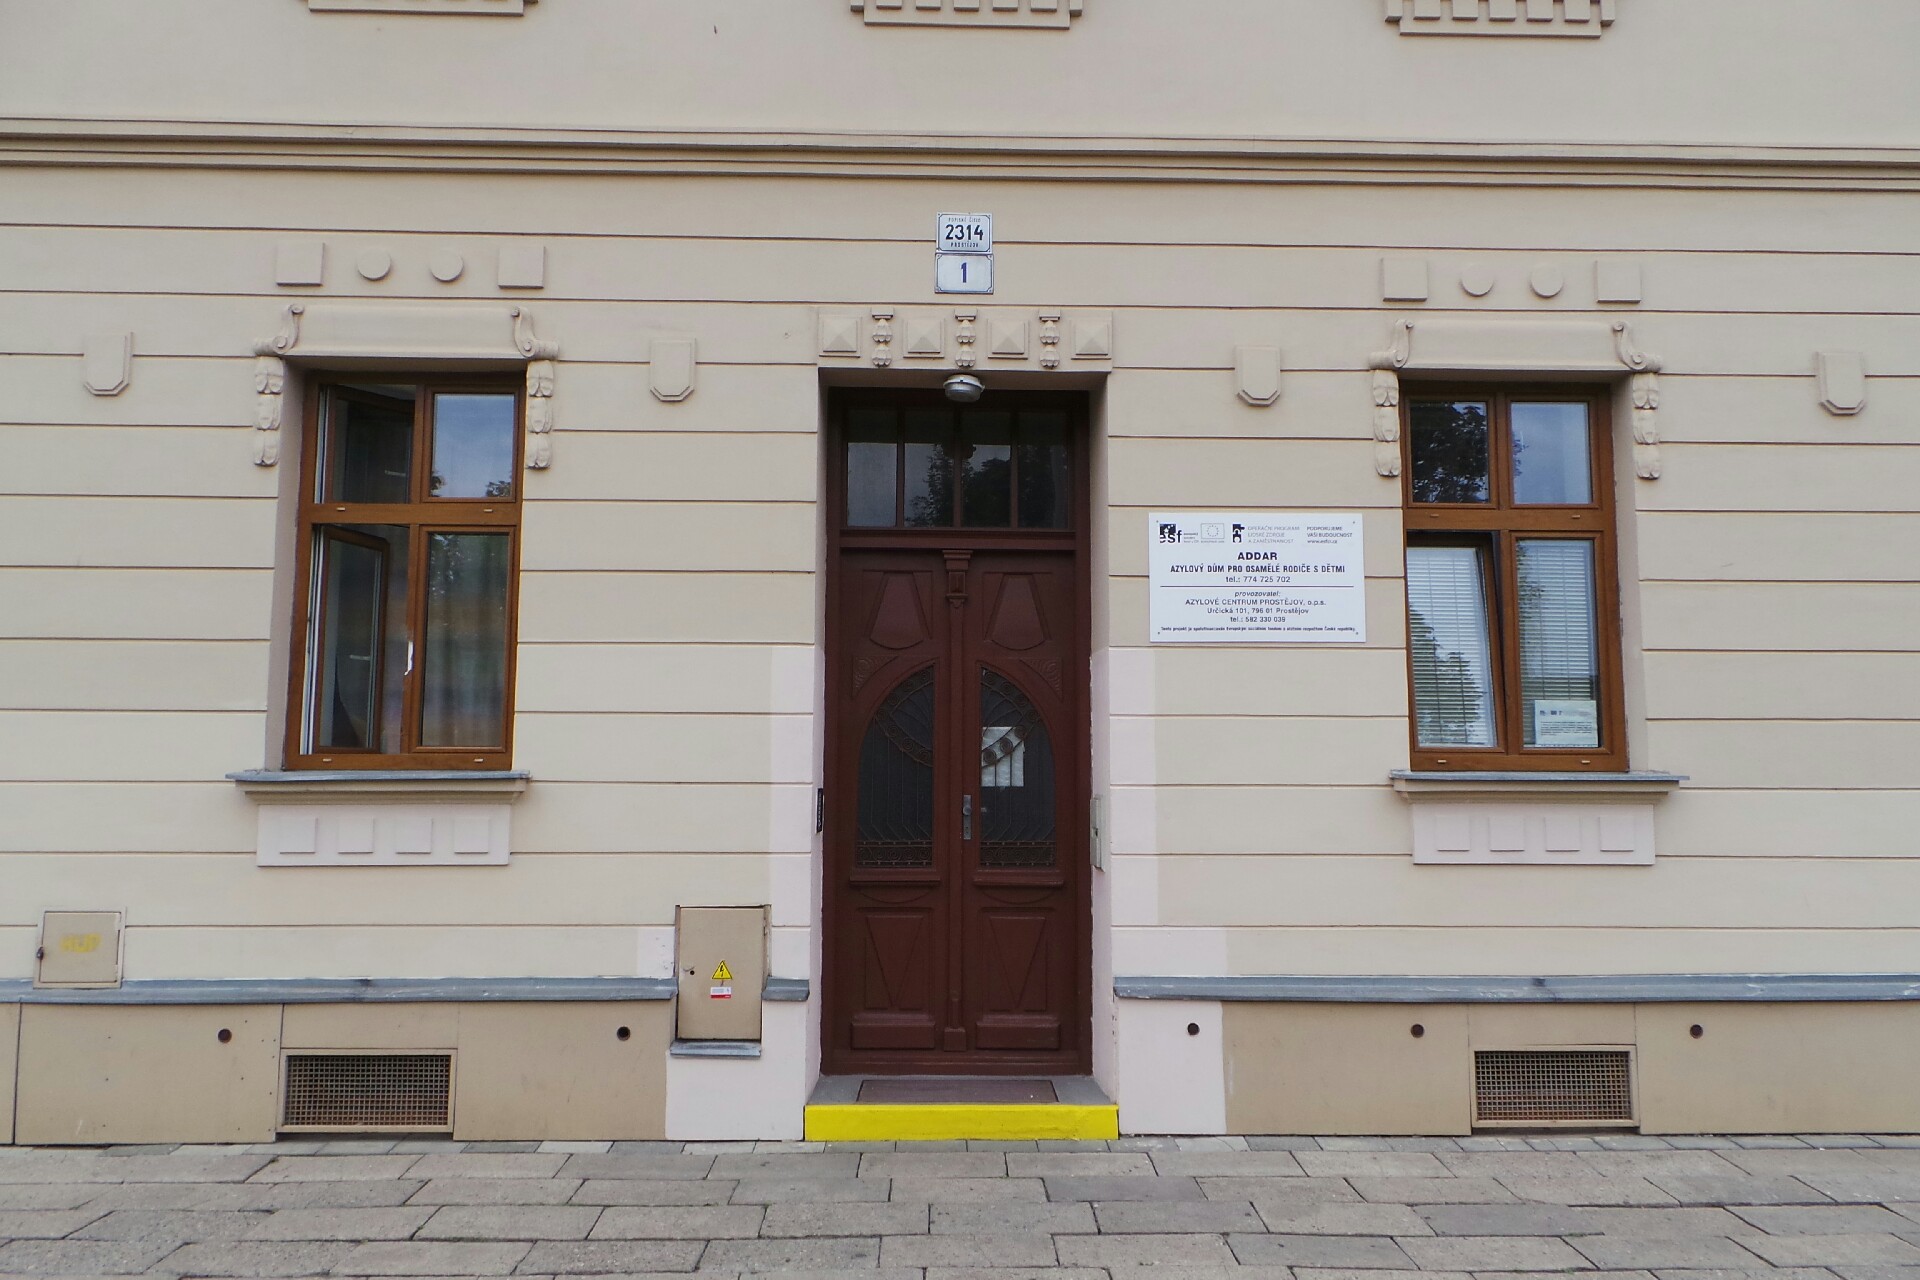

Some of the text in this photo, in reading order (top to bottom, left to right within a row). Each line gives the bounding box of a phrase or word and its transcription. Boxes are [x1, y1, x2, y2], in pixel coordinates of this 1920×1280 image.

[946, 224, 984, 240] 2314
[961, 262, 967, 283] 1
[1238, 552, 1278, 560] ADDAR
[1170, 563, 1204, 572] AZYLOVÝ
[1208, 563, 1224, 572] DŮM
[1246, 563, 1280, 572] OSAMĚLÉ
[1283, 564, 1310, 572] RODIČE
[1322, 564, 1345, 572] DĚTMI
[1185, 597, 1220, 605] AZYLOVÉ
